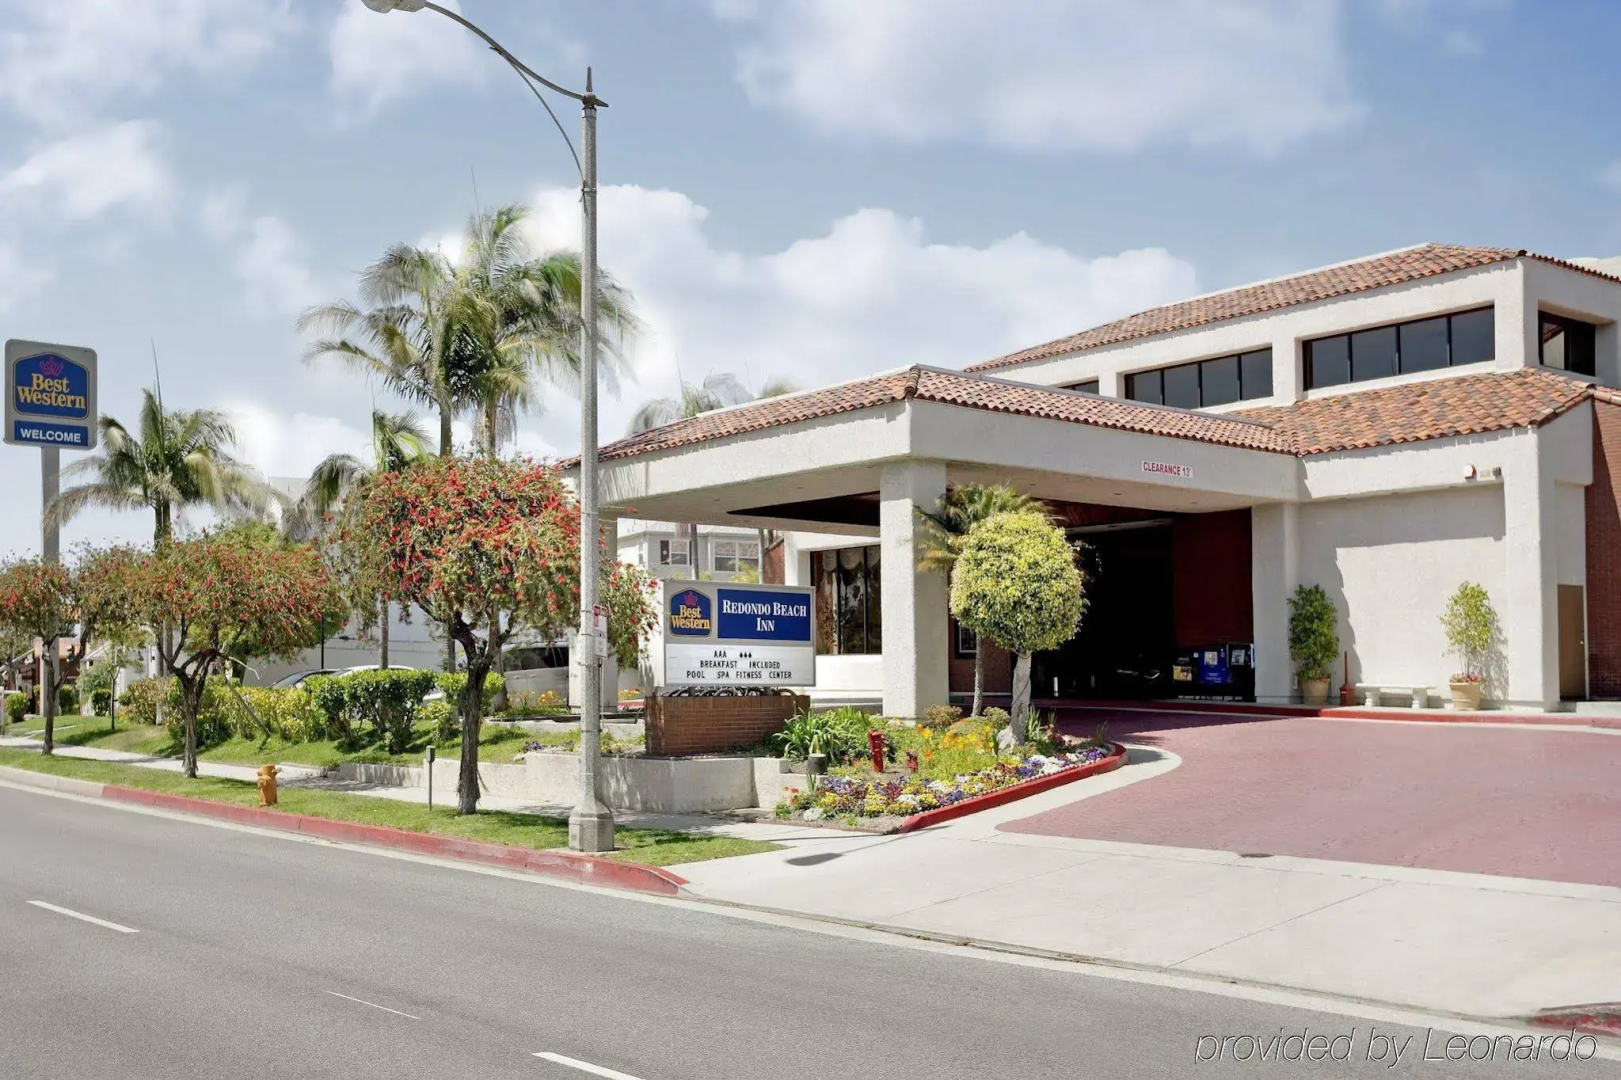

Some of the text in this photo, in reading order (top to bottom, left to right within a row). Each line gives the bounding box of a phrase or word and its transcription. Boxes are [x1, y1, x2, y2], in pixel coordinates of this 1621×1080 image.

[31, 373, 70, 393] Best
[17, 386, 85, 409] Western
[20, 428, 81, 443] WELCOME
[1143, 461, 1181, 476] CLEARANCE
[679, 605, 702, 618] Best
[671, 615, 711, 630] Western
[713, 650, 727, 658] AAA
[700, 660, 781, 669] BREAKFAST INCLUDED
[686, 671, 792, 679] POOL SPA FITNESS CENTER
